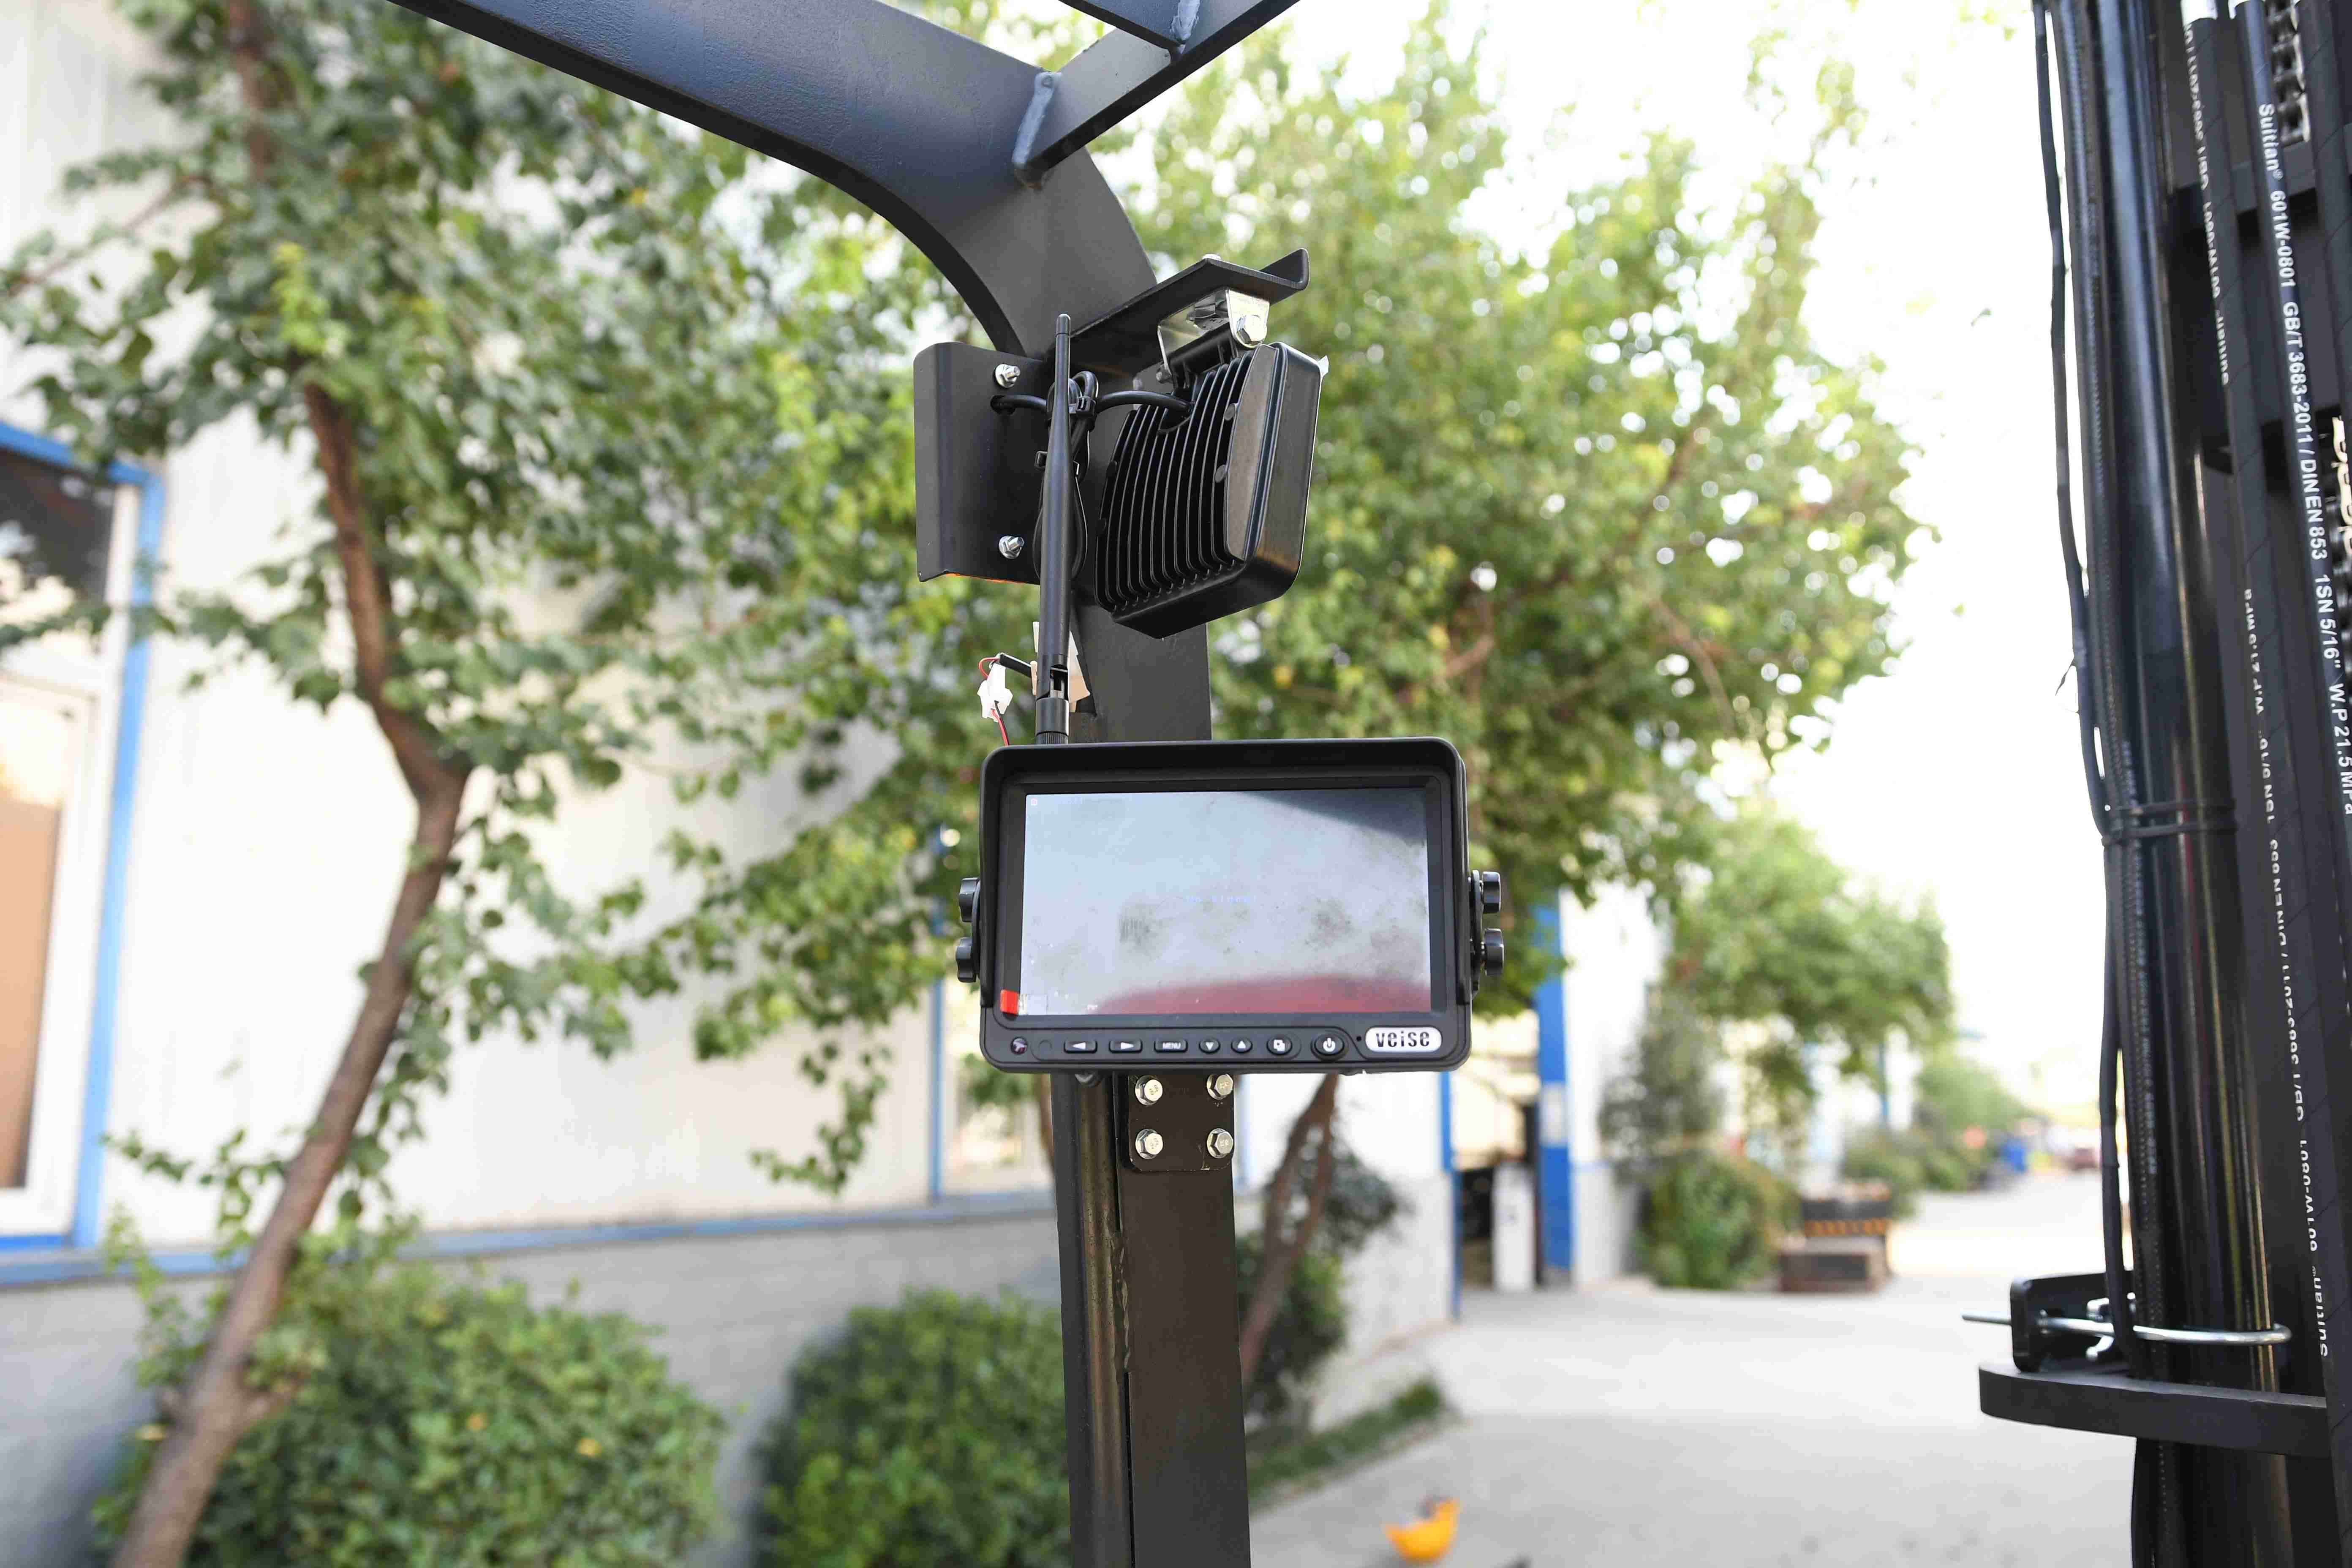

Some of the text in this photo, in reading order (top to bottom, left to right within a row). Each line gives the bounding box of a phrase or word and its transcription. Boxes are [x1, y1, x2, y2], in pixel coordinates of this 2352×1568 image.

[2270, 190, 2296, 287] 601W-0801
[2283, 301, 2303, 348] GB/T
[2288, 352, 2313, 444] 3683-2011
[2300, 459, 2319, 493] DIN
[2305, 496, 2324, 523] EN
[2309, 526, 2327, 560] 853
[2315, 574, 2334, 613] 1SN
[2320, 619, 2341, 668] 5/16"
[2329, 683, 2347, 721] W.P
[2334, 726, 2352, 767] 21.5
[1376, 1031, 1429, 1047] veise
